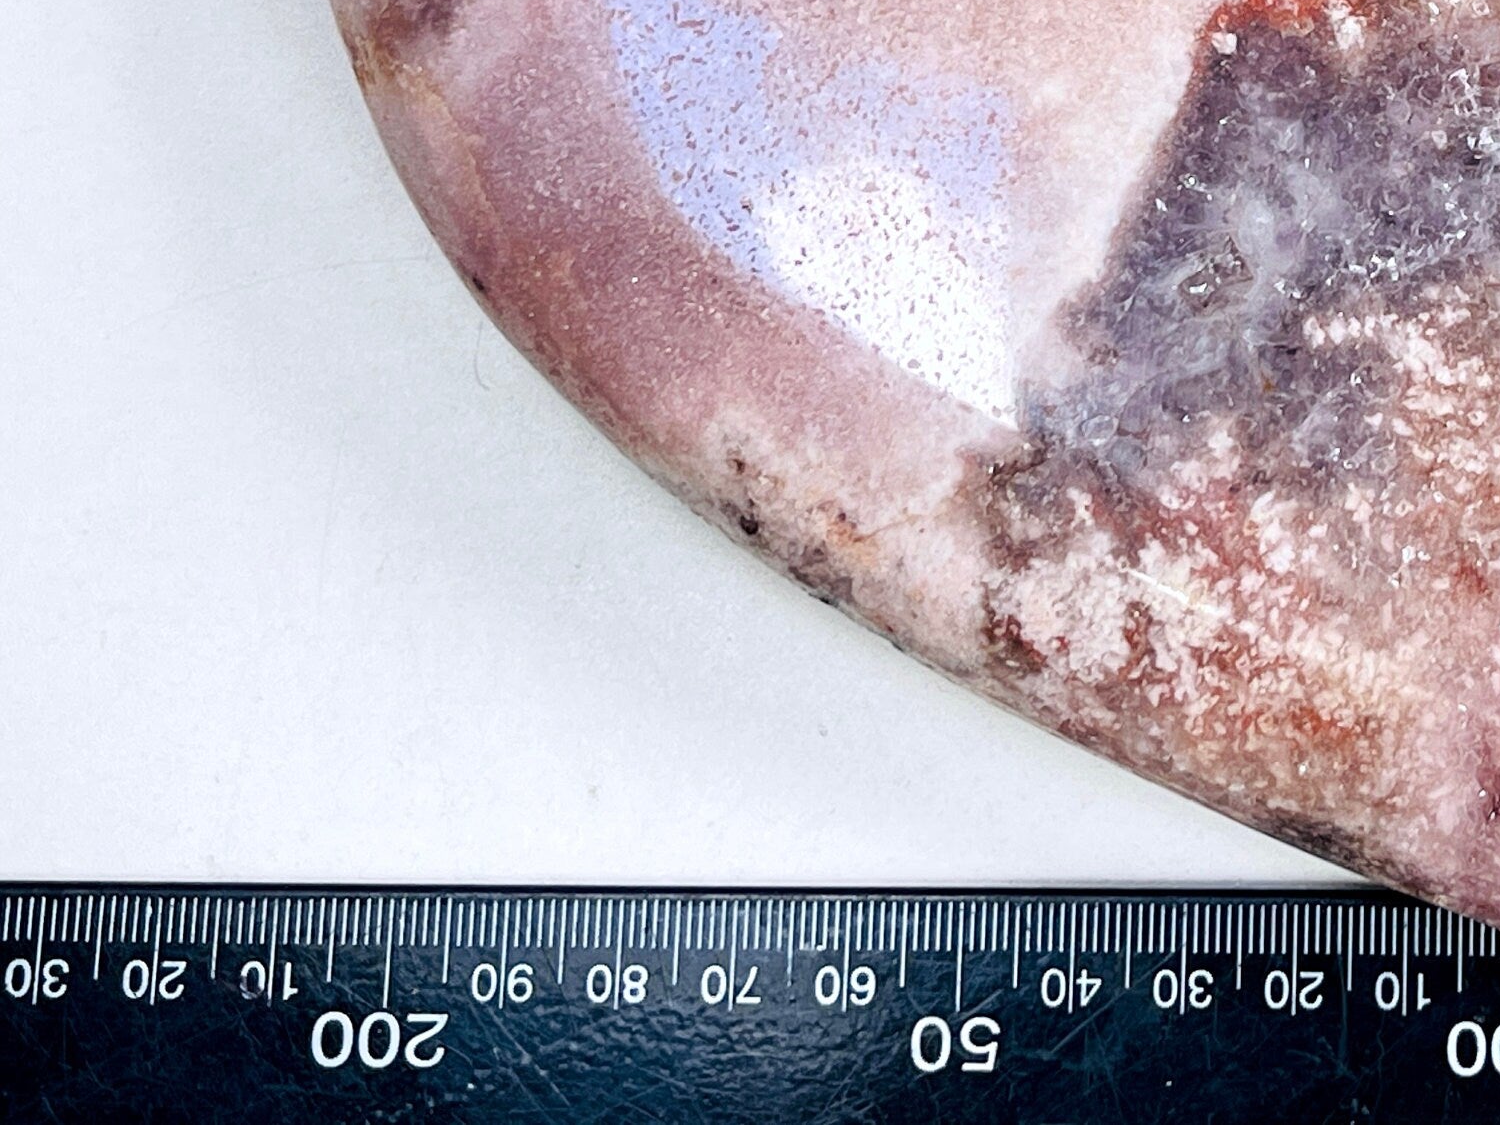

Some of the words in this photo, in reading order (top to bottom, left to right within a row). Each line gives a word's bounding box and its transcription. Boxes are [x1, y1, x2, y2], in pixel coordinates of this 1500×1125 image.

[5, 960, 68, 996] 30
[122, 960, 186, 999] 20
[240, 961, 298, 1001] 10
[472, 962, 534, 1003] 90
[586, 964, 648, 1004] 80
[701, 964, 762, 1005] 70
[815, 965, 876, 1007] 60
[1041, 968, 1102, 1009] 40
[1153, 970, 1214, 1009] 30
[1264, 970, 1324, 1010] 20
[1375, 971, 1430, 1011] 10
[310, 1011, 449, 1068] 200
[910, 1015, 1002, 1073] 50
